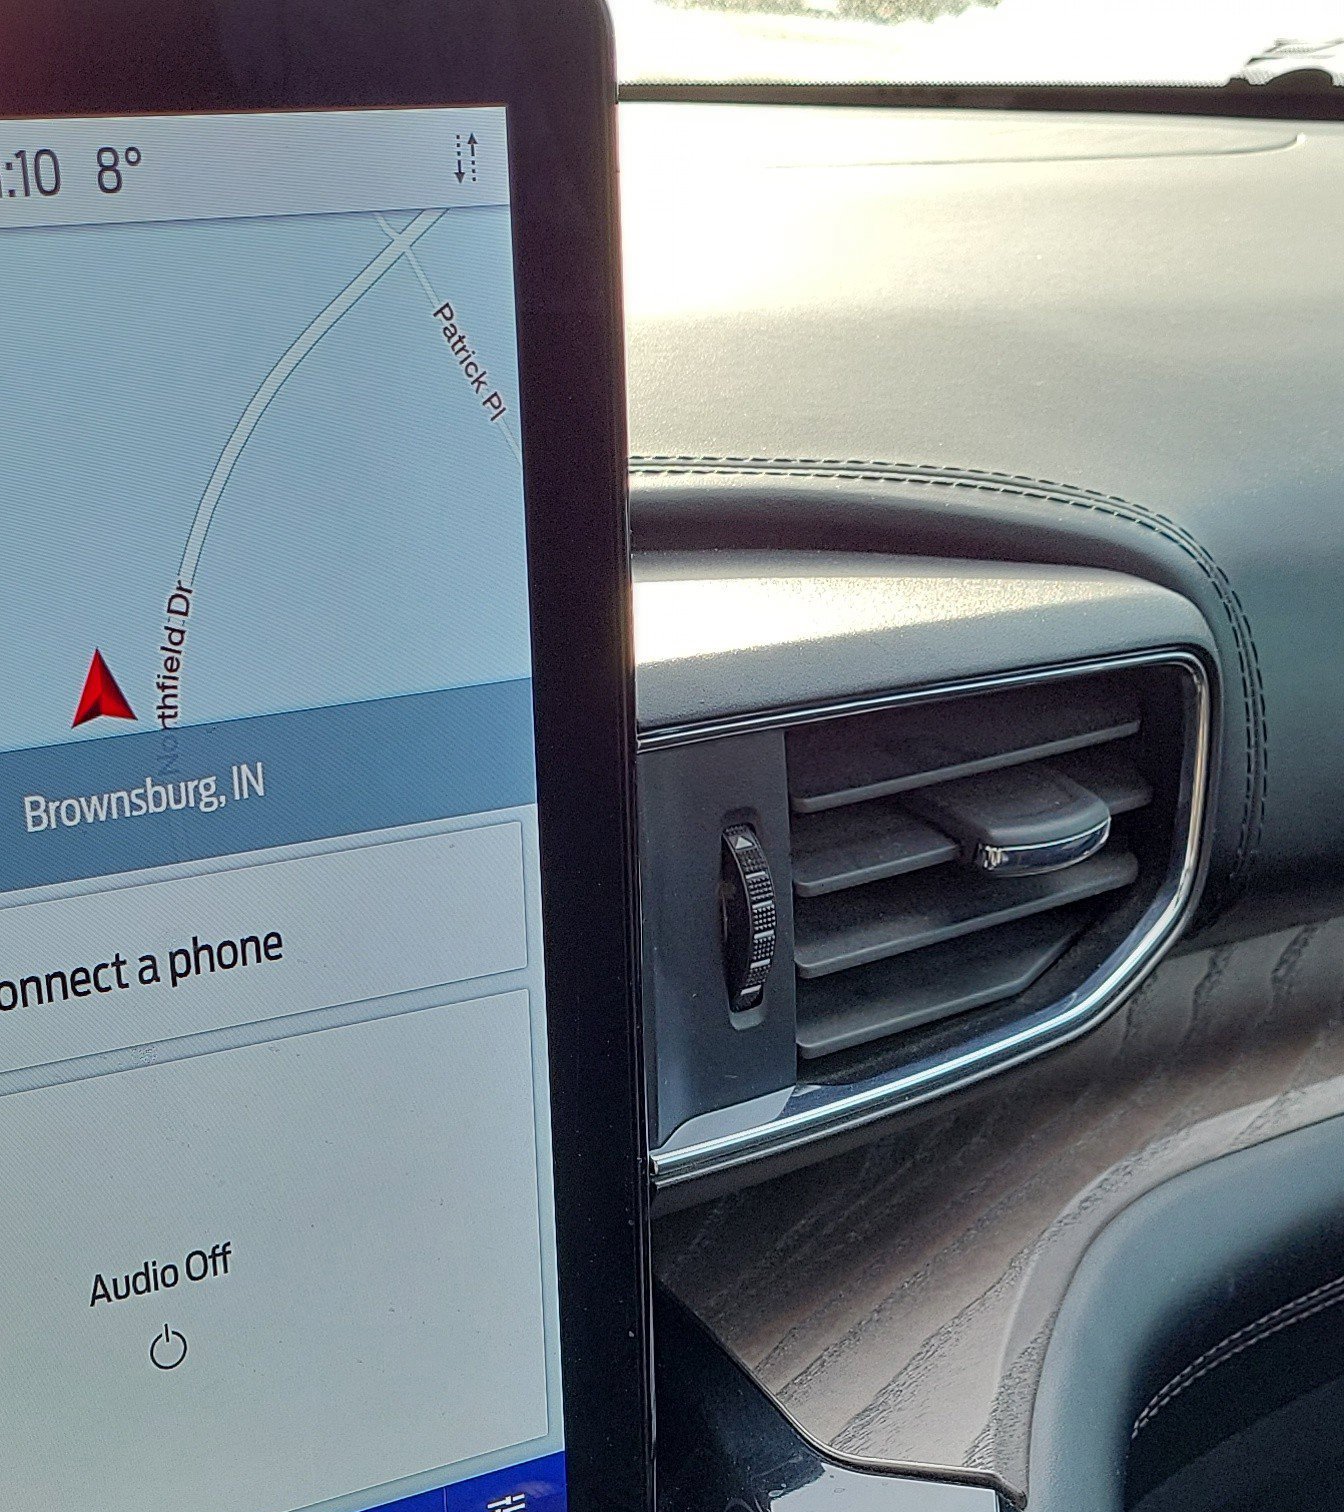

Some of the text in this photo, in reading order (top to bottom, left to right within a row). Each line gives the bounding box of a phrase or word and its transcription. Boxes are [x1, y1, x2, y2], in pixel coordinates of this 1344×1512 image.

[433, 302, 487, 394] Patrick
[166, 580, 193, 617] Dr
[24, 761, 265, 833] Brownsburg, IN
[138, 953, 161, 986] a
[168, 931, 284, 988] phone
[89, 1241, 232, 1308] Audio Off
